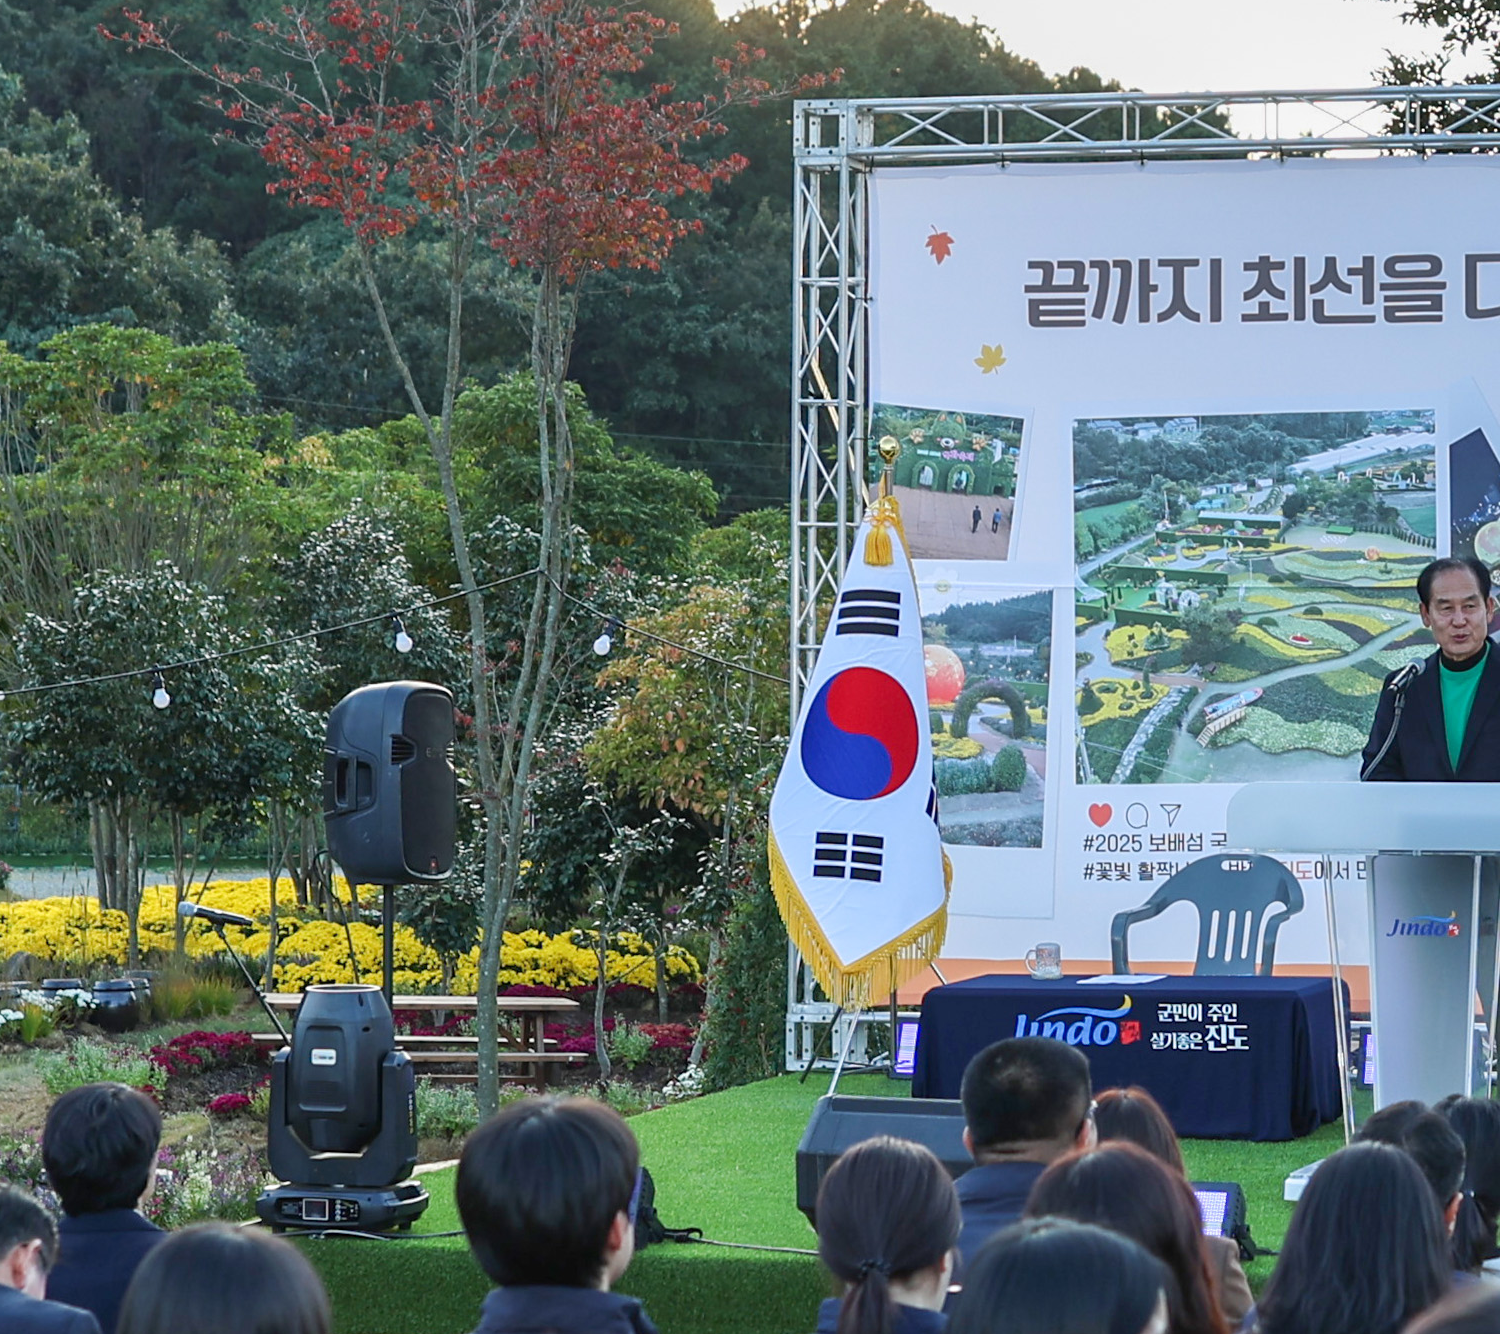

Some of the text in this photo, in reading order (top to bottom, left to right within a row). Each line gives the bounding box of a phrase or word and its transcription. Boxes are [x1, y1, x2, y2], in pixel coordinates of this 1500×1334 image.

[1023, 257, 1222, 328] 끝까지
[1240, 253, 1447, 324] 최선을
[1084, 834, 1142, 852] #2025
[1149, 832, 1203, 852] 보배섬
[1084, 861, 1190, 881] #꽃빛 활짝
[1386, 919, 1446, 937] Jindo
[1157, 1003, 1238, 1023] 군민이 주인
[1204, 1025, 1249, 1052] 진도
